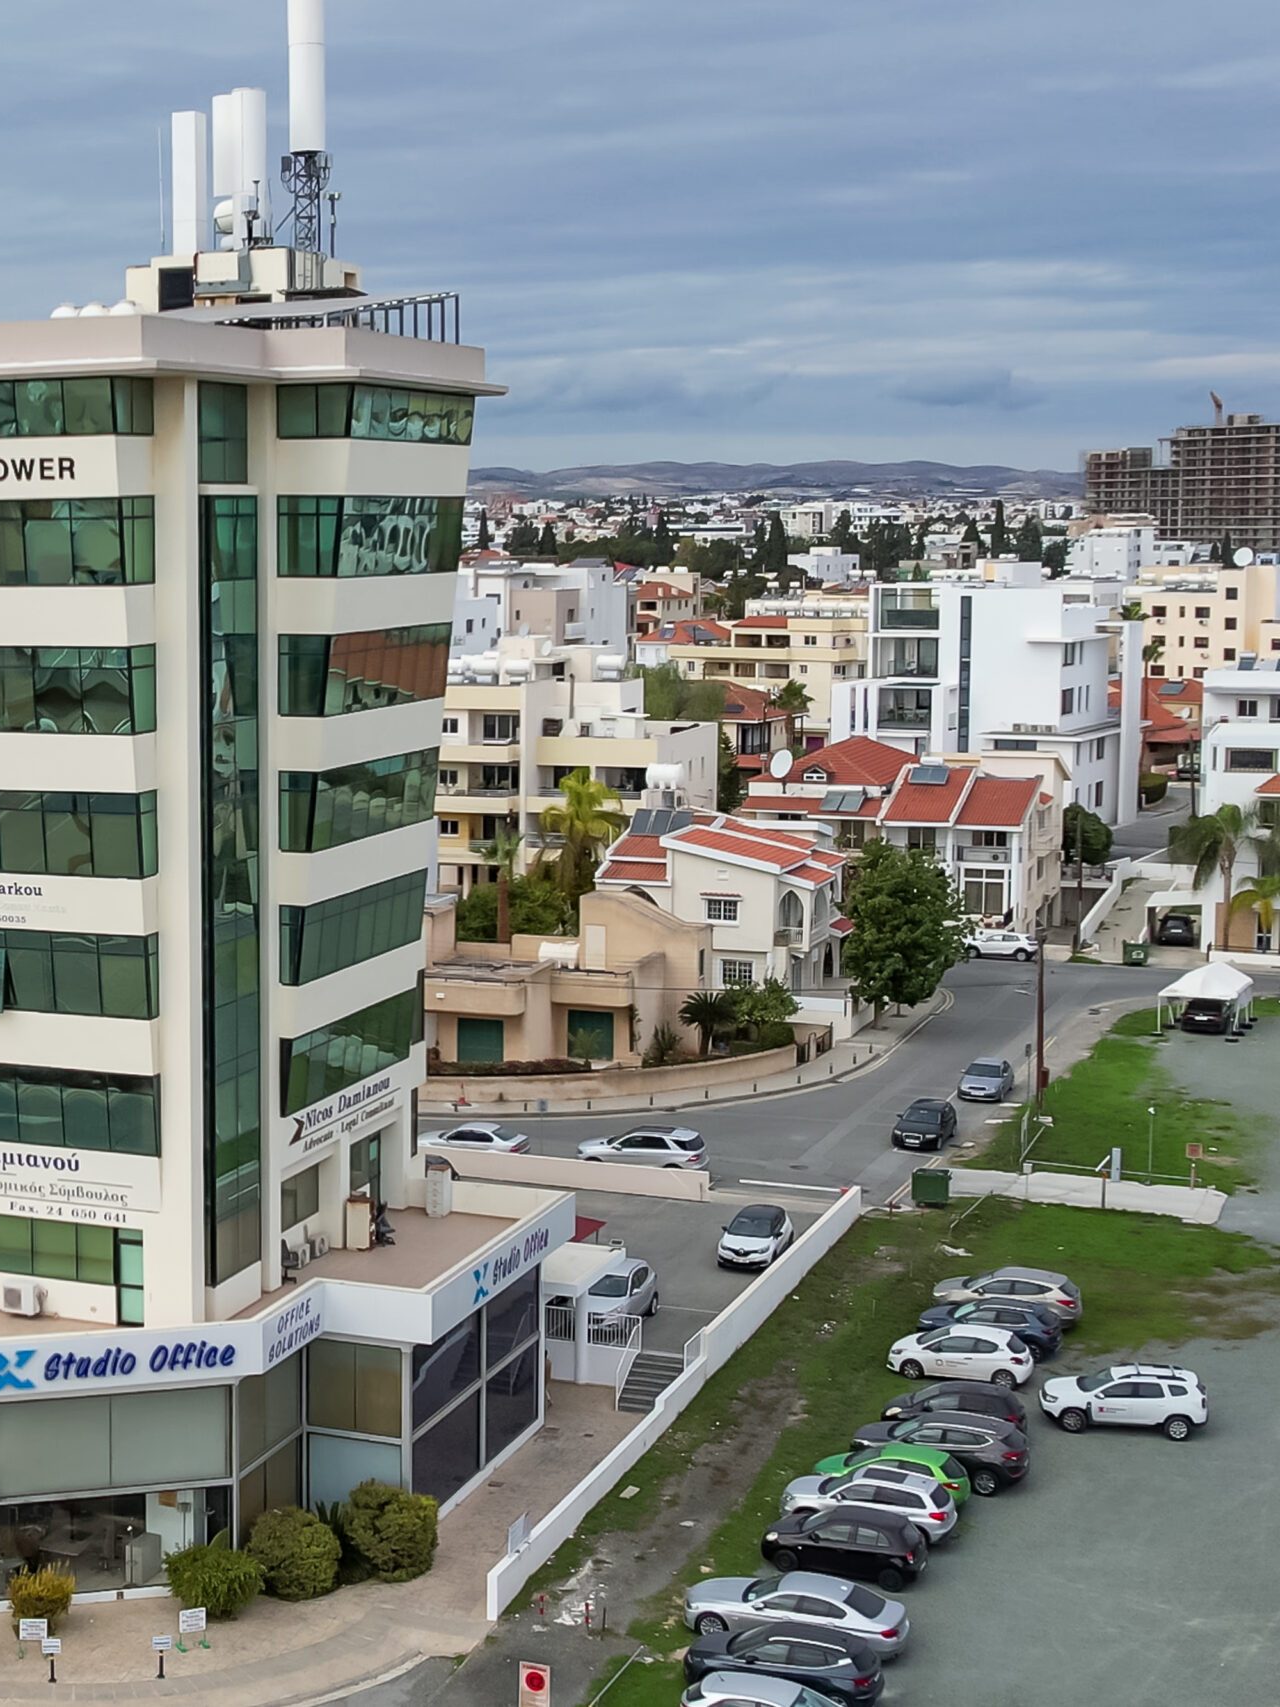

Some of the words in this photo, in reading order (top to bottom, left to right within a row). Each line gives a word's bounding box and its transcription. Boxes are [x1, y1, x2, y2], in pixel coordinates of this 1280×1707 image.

[305, 1106, 334, 1131] Nicos
[338, 1078, 391, 1113] Damianou
[49, 1183, 128, 1207] Σύμβουλος
[71, 1208, 97, 1220] 650
[492, 1245, 521, 1286] Studio
[523, 1228, 549, 1262] Office
[277, 1297, 312, 1335] OFFICE
[268, 1313, 321, 1363] SOLUTIONS
[43, 1347, 136, 1382] Studio
[149, 1340, 236, 1374] Office
